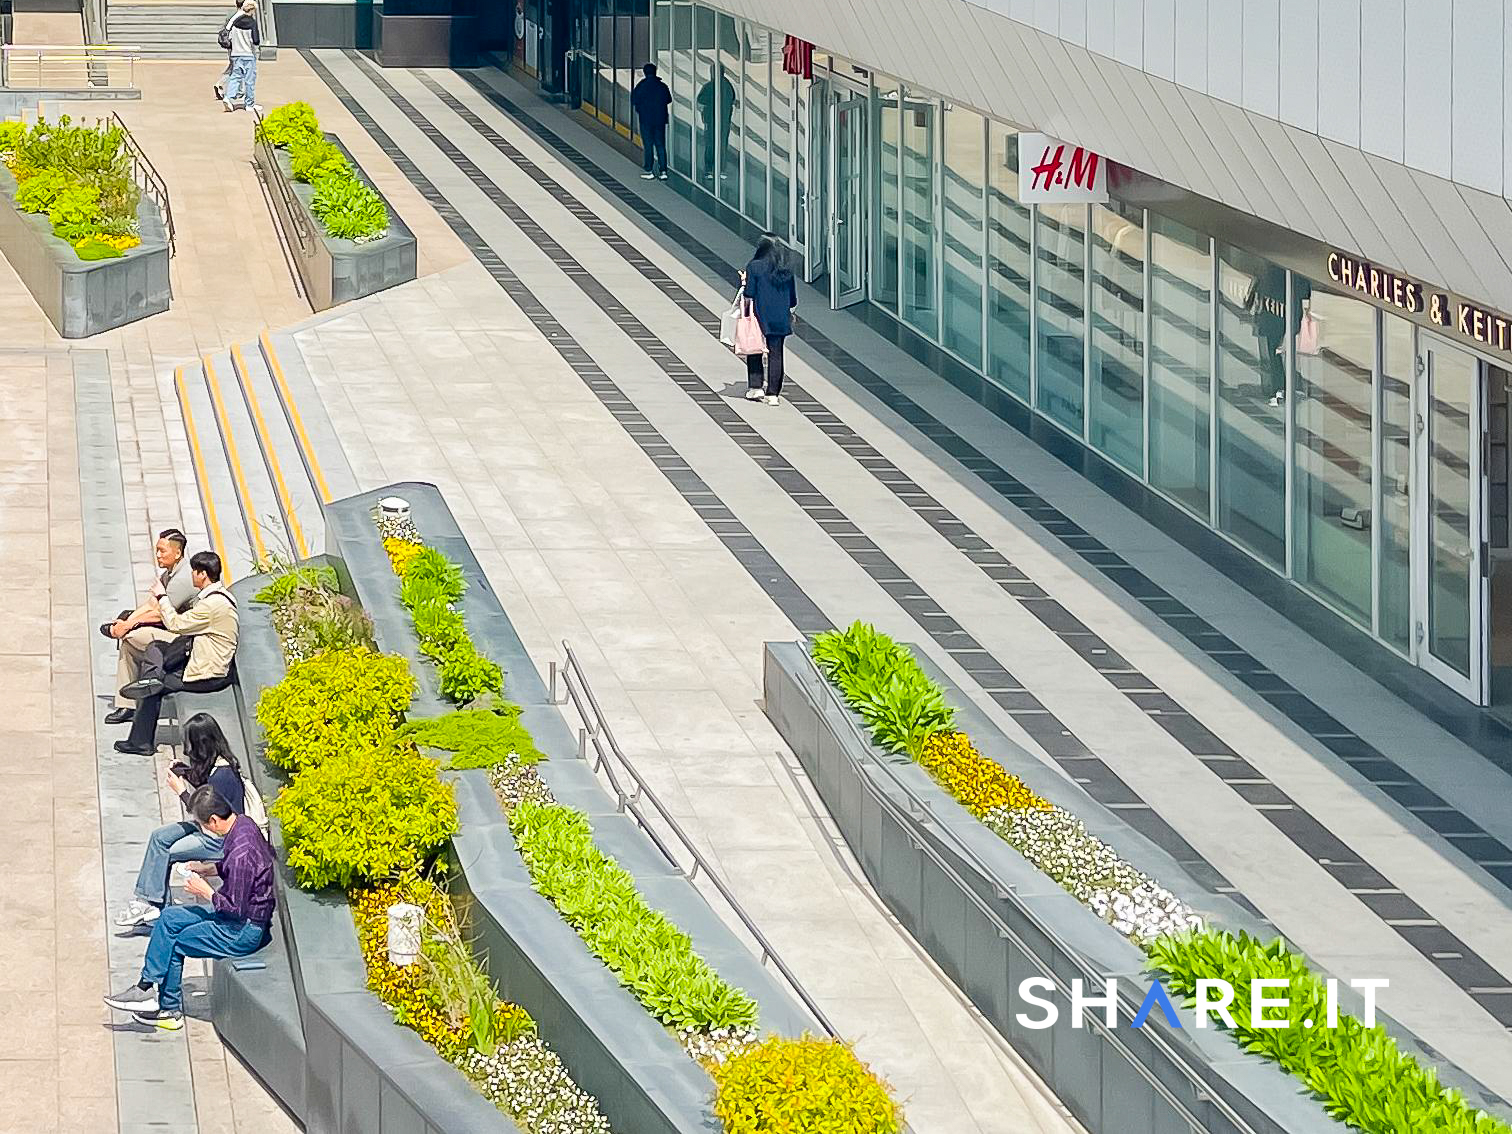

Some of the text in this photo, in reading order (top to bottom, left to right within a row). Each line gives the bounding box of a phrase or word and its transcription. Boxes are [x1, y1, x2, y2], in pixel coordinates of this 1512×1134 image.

[1031, 145, 1099, 192] H&M
[1327, 252, 1417, 313] CHARLES
[1430, 293, 1446, 325] &
[1458, 303, 1512, 354] KEIT
